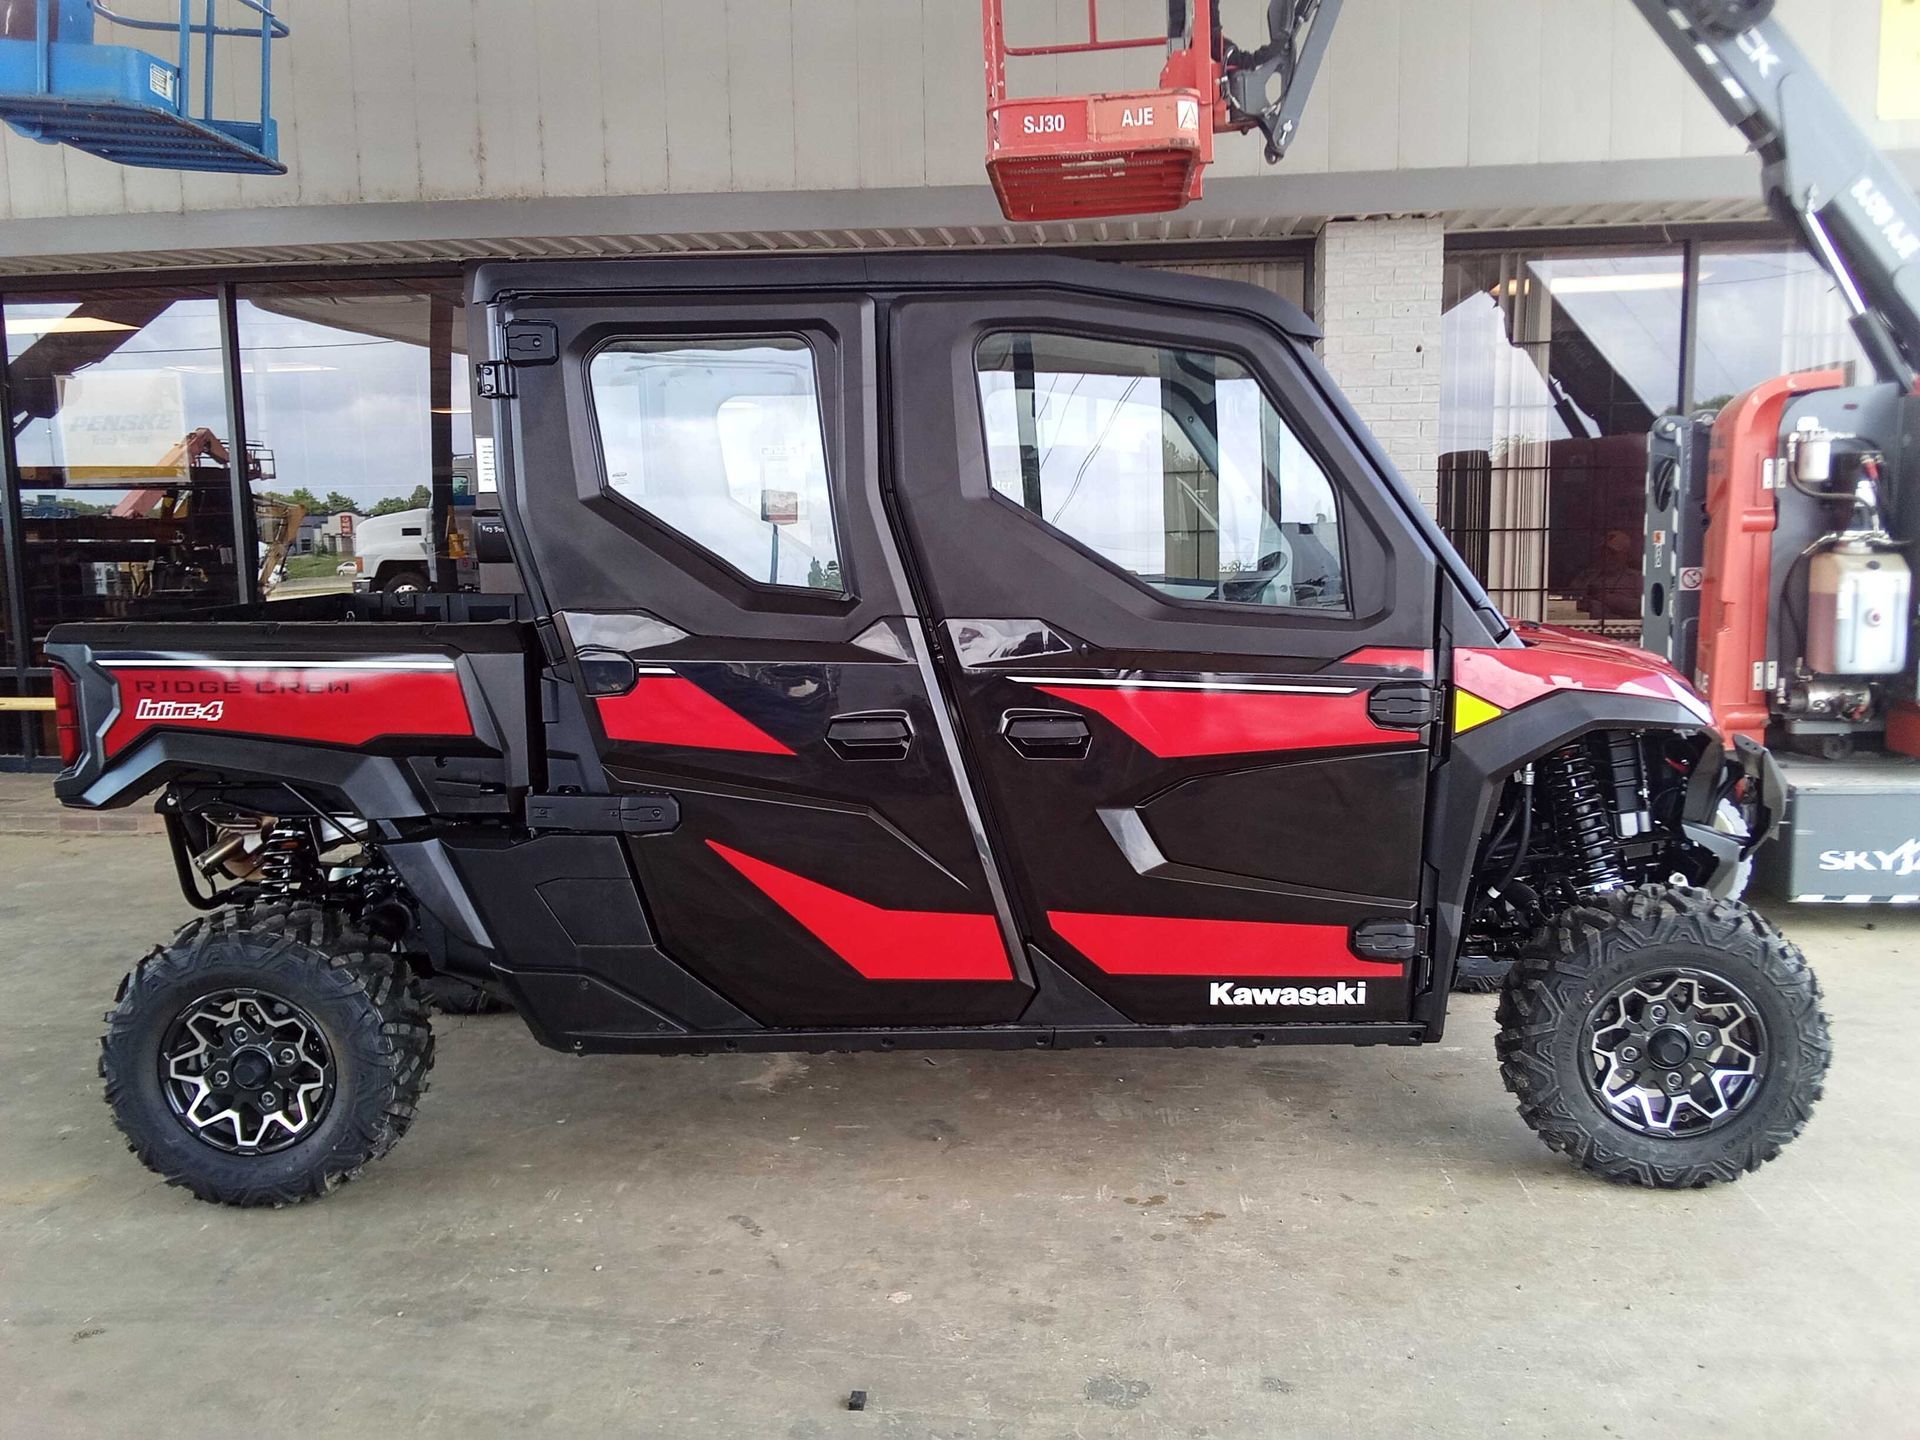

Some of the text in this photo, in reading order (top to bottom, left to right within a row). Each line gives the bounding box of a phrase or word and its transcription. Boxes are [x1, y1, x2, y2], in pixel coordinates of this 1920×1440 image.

[1023, 107, 1154, 133] SJ30 AJE
[69, 414, 171, 432] PENSKE
[135, 680, 350, 693] RIDGE CREW
[135, 699, 224, 721] Inline-4
[1209, 981, 1367, 1006] Kawasaki
